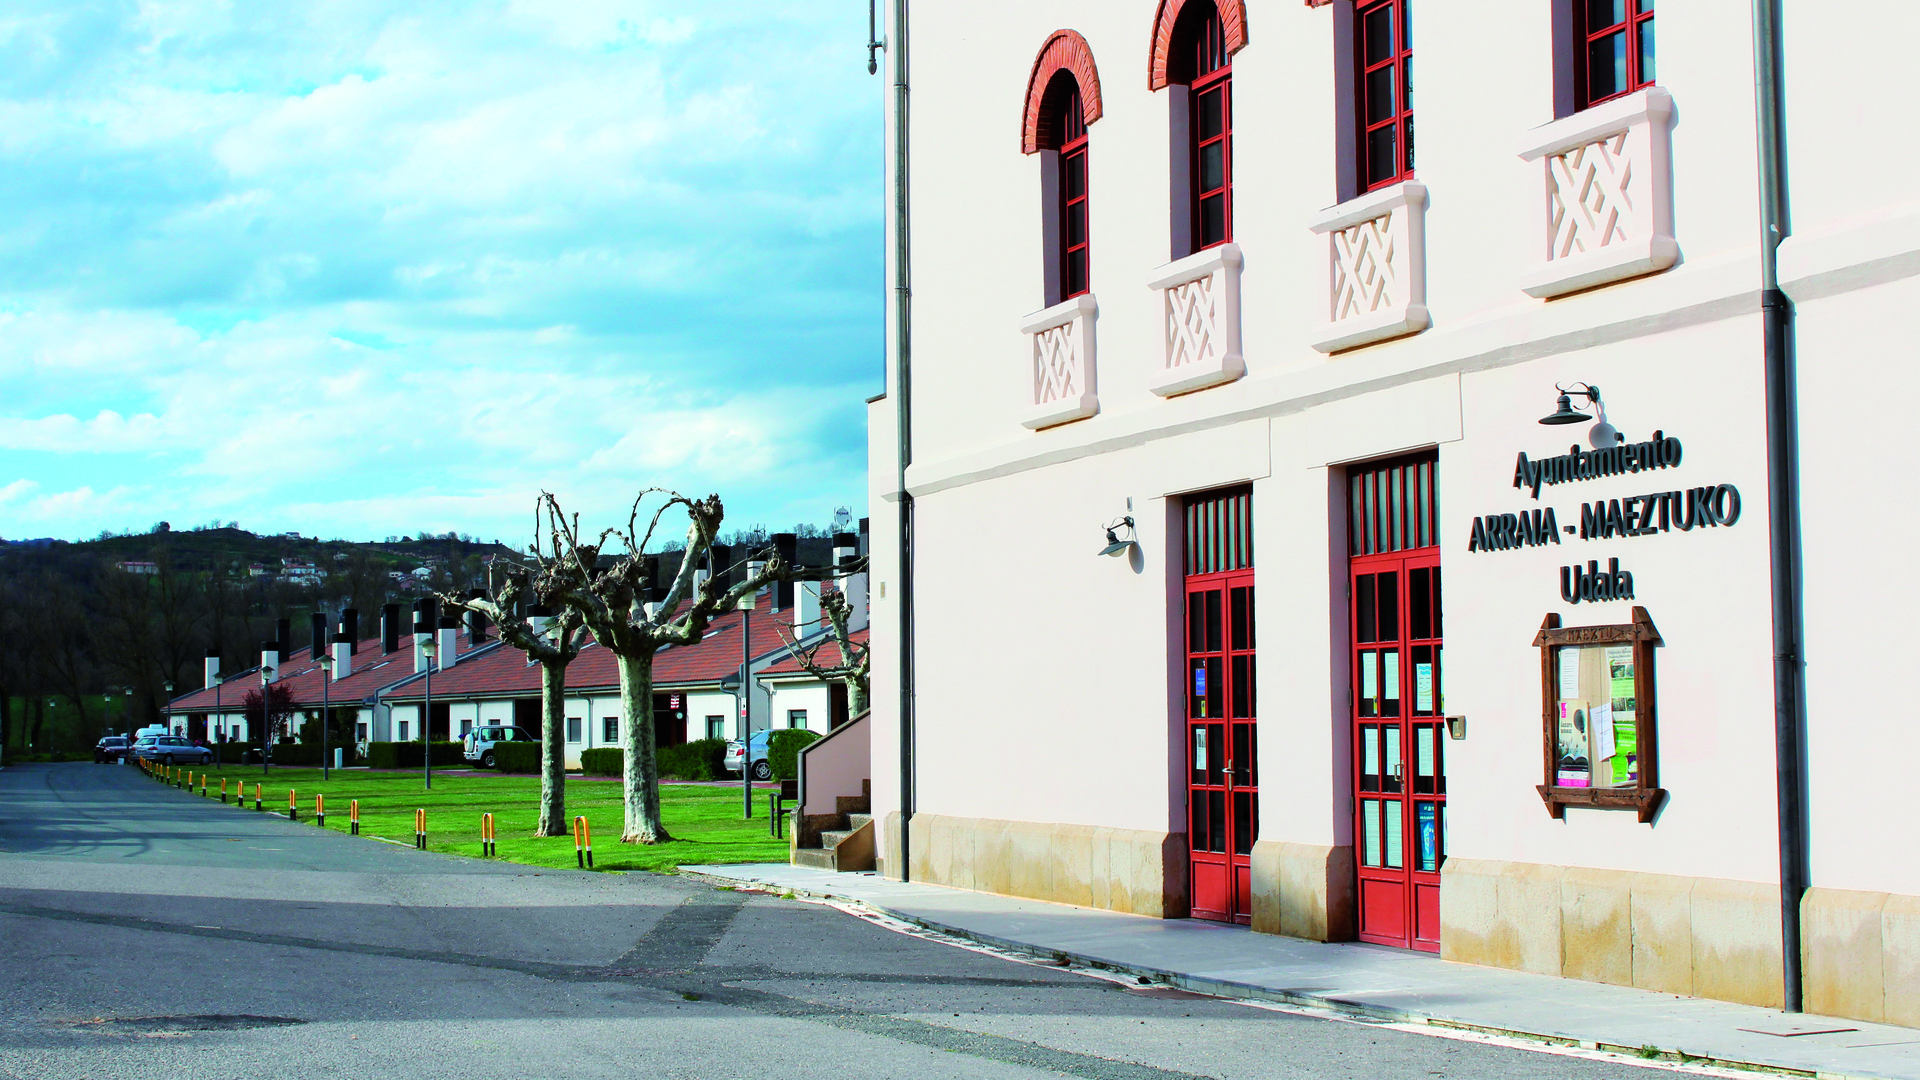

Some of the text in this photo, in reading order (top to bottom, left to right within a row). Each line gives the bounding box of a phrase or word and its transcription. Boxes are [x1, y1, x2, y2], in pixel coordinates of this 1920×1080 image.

[1512, 429, 1682, 500] Ayuntamiento
[1468, 507, 1560, 553] ARRAIA
[1580, 483, 1741, 542] MAEZTUKO
[1559, 557, 1635, 605] Udala
